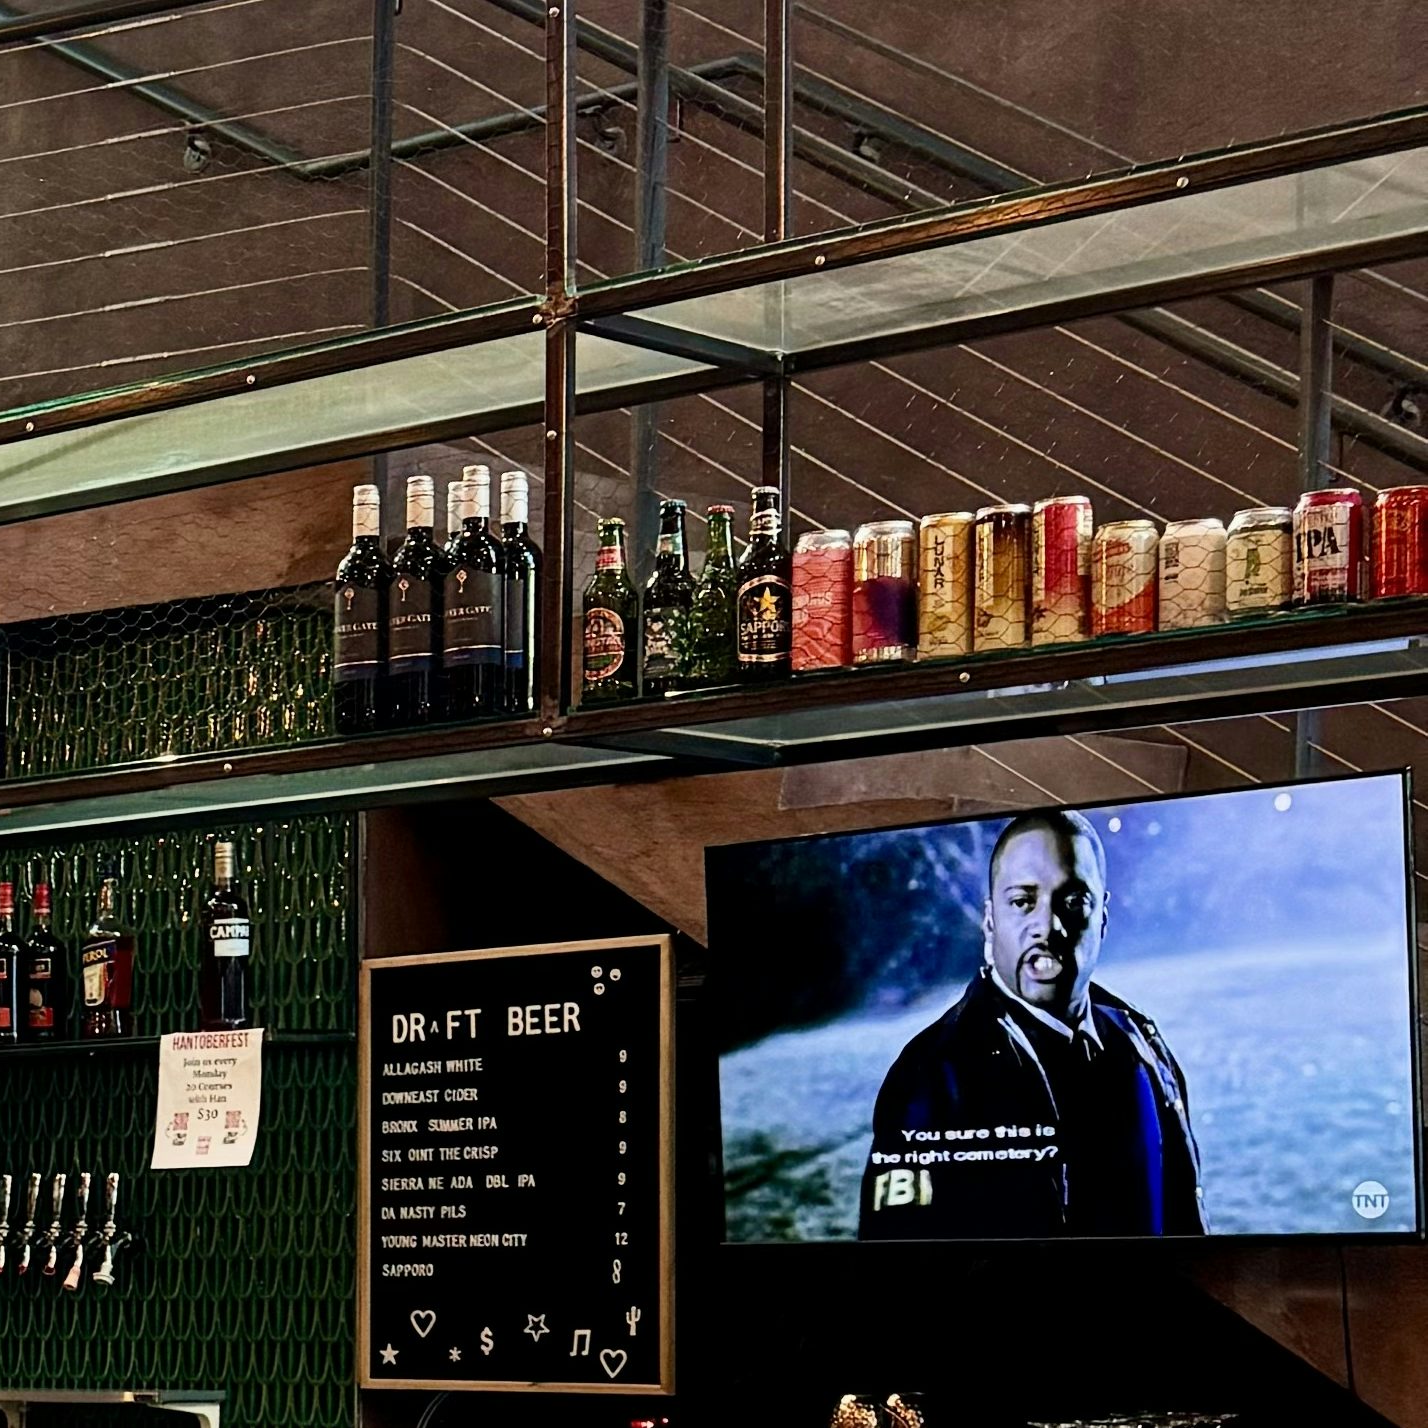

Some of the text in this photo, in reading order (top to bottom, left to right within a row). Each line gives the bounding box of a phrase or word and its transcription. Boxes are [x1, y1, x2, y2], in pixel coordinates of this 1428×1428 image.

[1295, 526, 1342, 563] IPA
[933, 535, 945, 589] LUNAR
[507, 1002, 580, 1036] BEER
[173, 1032, 249, 1051] HANTOBERFEST
[214, 1058, 238, 1067] every
[382, 1049, 627, 1076] ALLAGASH WHITE 9
[192, 1069, 227, 1080] Monday
[382, 1080, 627, 1105] DOWNEAST CIDER 9
[381, 1120, 418, 1134] BRONX
[427, 1117, 474, 1132] SUMMER
[478, 1116, 498, 1130] IPA
[901, 1123, 1055, 1142] You sure this is
[381, 1149, 402, 1163] SIX
[439, 1147, 461, 1161] THE
[463, 1146, 499, 1160] CRISP
[618, 1140, 627, 1154] 9
[871, 1151, 901, 1164] the
[904, 1149, 950, 1165] right
[381, 1177, 425, 1191] SIERRA
[485, 1174, 510, 1188] DBL
[517, 1174, 536, 1187] IPA
[617, 1172, 626, 1185] 9
[873, 1168, 933, 1212] FBI
[381, 1201, 626, 1220] DA NASTY PILS 7
[1352, 1194, 1389, 1208] TNT
[381, 1232, 628, 1249] YOUNG MASTER NEON CITY 12
[382, 1263, 434, 1277] SAPPORO
